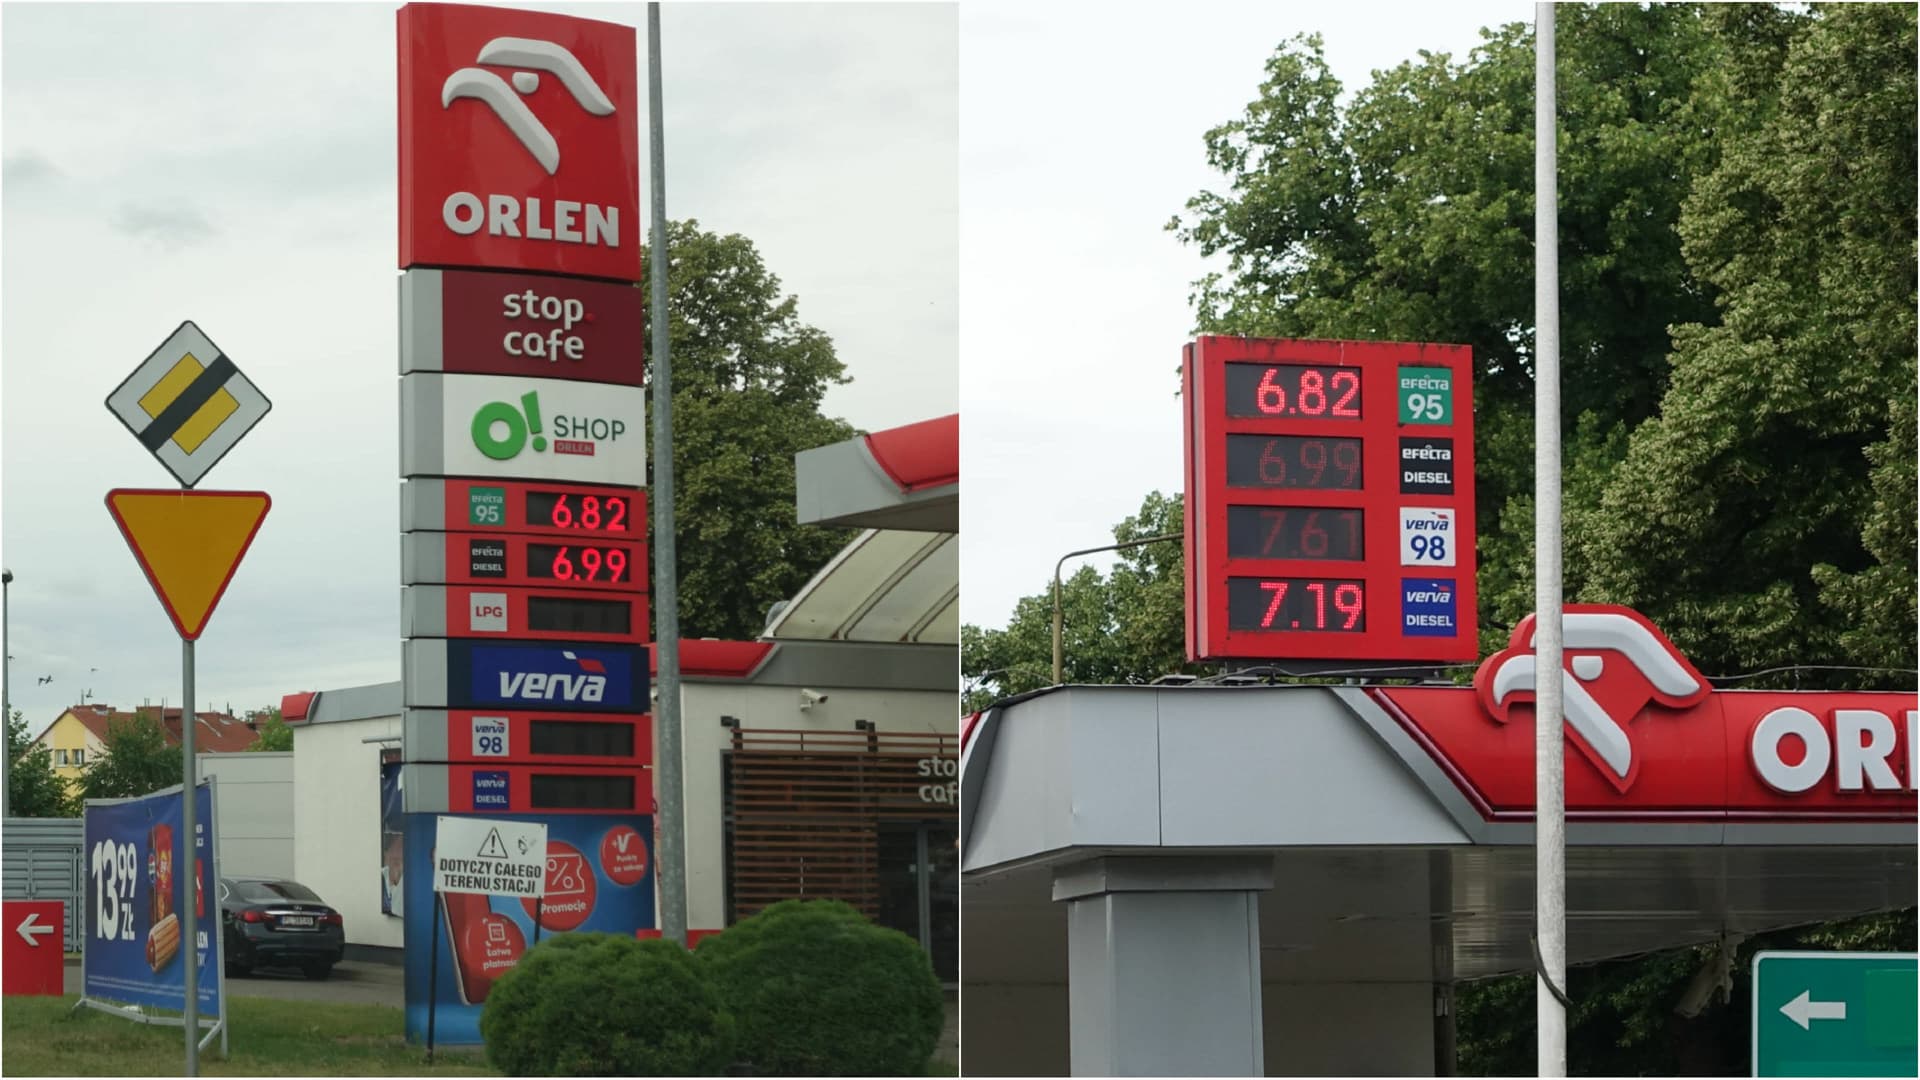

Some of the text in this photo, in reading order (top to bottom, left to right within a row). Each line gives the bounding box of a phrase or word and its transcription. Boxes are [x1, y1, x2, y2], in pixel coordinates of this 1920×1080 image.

[443, 191, 620, 248] ORLEN
[503, 328, 585, 361] cafe
[1257, 368, 1359, 416] 6.82
[1407, 393, 1444, 420] 95
[553, 415, 626, 442] SHOP
[556, 441, 593, 453] ORLEN
[1259, 439, 1360, 486] 6.99
[1404, 471, 1452, 484] DIESEL
[475, 505, 499, 523] 95
[552, 494, 626, 531] 6.82
[1406, 519, 1449, 531] verva
[1410, 534, 1446, 561] 98
[472, 562, 503, 572] DIESEL
[552, 546, 627, 583] 6.99
[1260, 582, 1363, 630] 7.19
[1406, 591, 1451, 604] verva
[476, 606, 503, 618] LPG
[1406, 614, 1454, 627] DIESEL
[500, 671, 607, 702] verva
[475, 724, 506, 735] verva
[478, 736, 503, 754] 98
[917, 755, 958, 777] sto
[476, 778, 506, 789] verva
[476, 794, 507, 804] DIESEL
[918, 782, 959, 806] caf
[440, 858, 542, 879] DOTYCZY CAŁEGO
[444, 874, 536, 893] TERENU STACJI
[541, 899, 587, 914] Promocje
